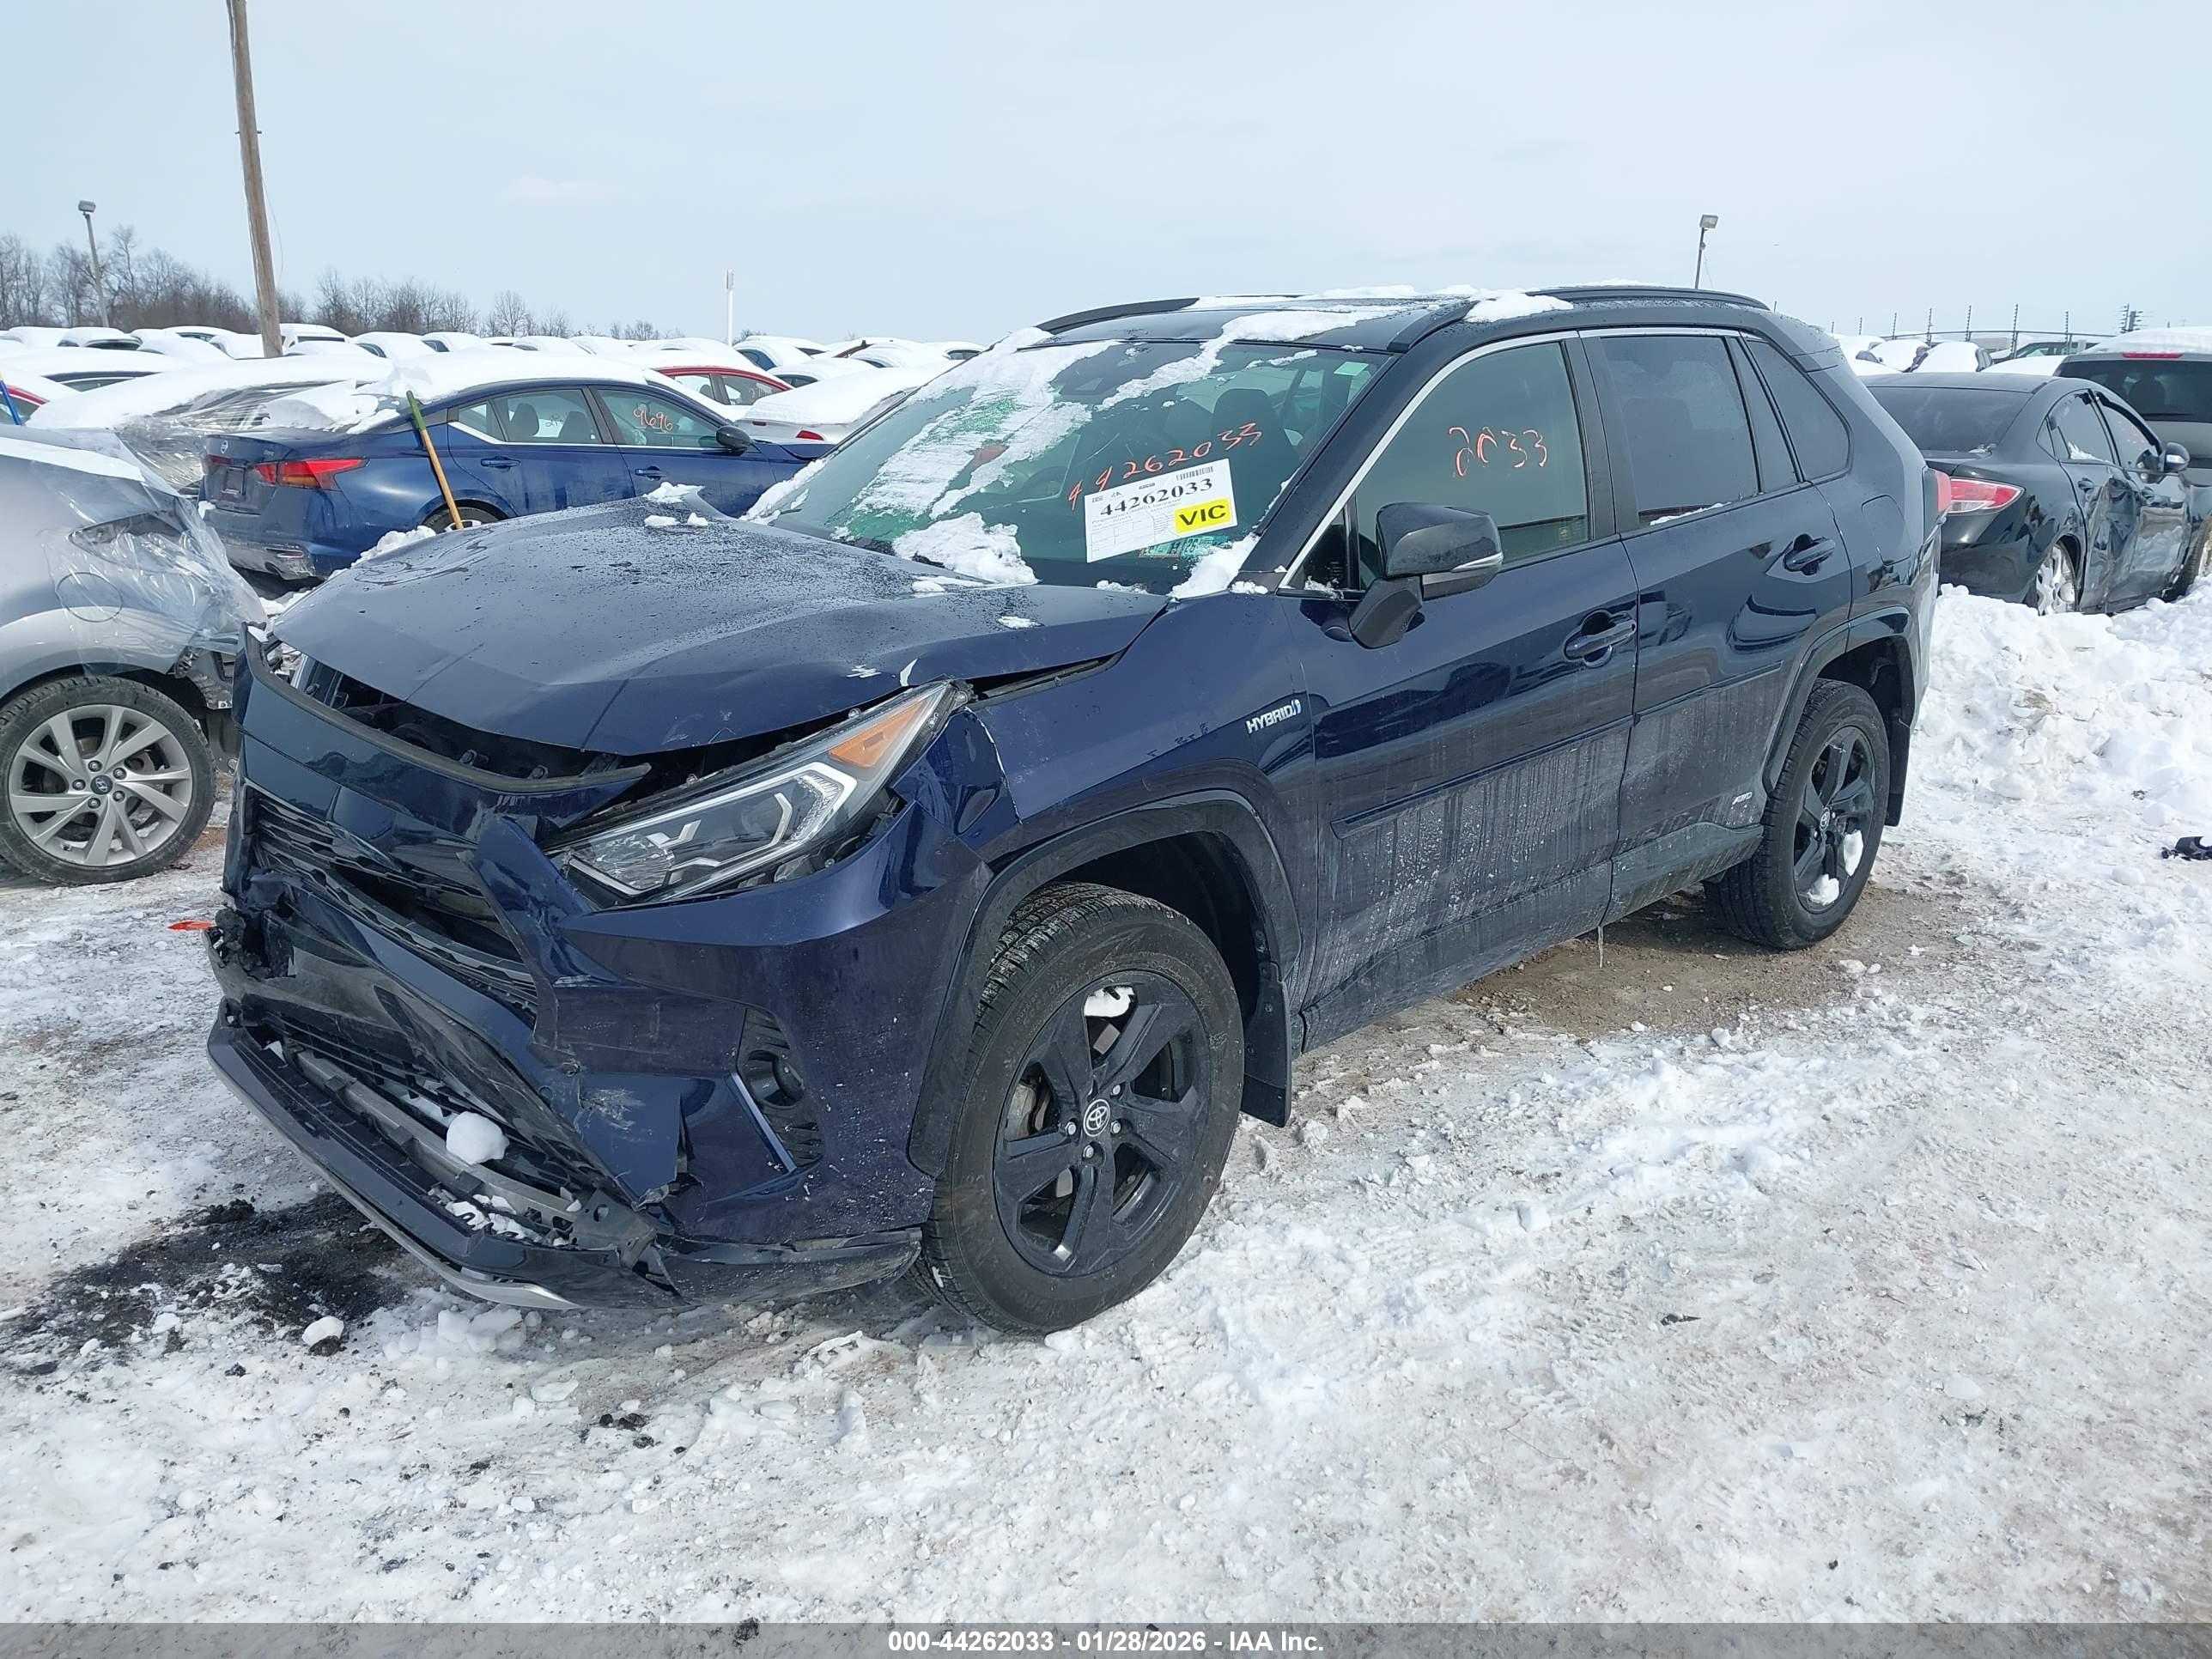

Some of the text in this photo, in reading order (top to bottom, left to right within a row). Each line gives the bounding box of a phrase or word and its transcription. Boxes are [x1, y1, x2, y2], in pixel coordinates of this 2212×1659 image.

[1449, 426, 1547, 477] 2033
[1100, 477, 1212, 516] 44262033
[1179, 504, 1226, 526] VIC
[1246, 704, 1297, 734] HYBRID
